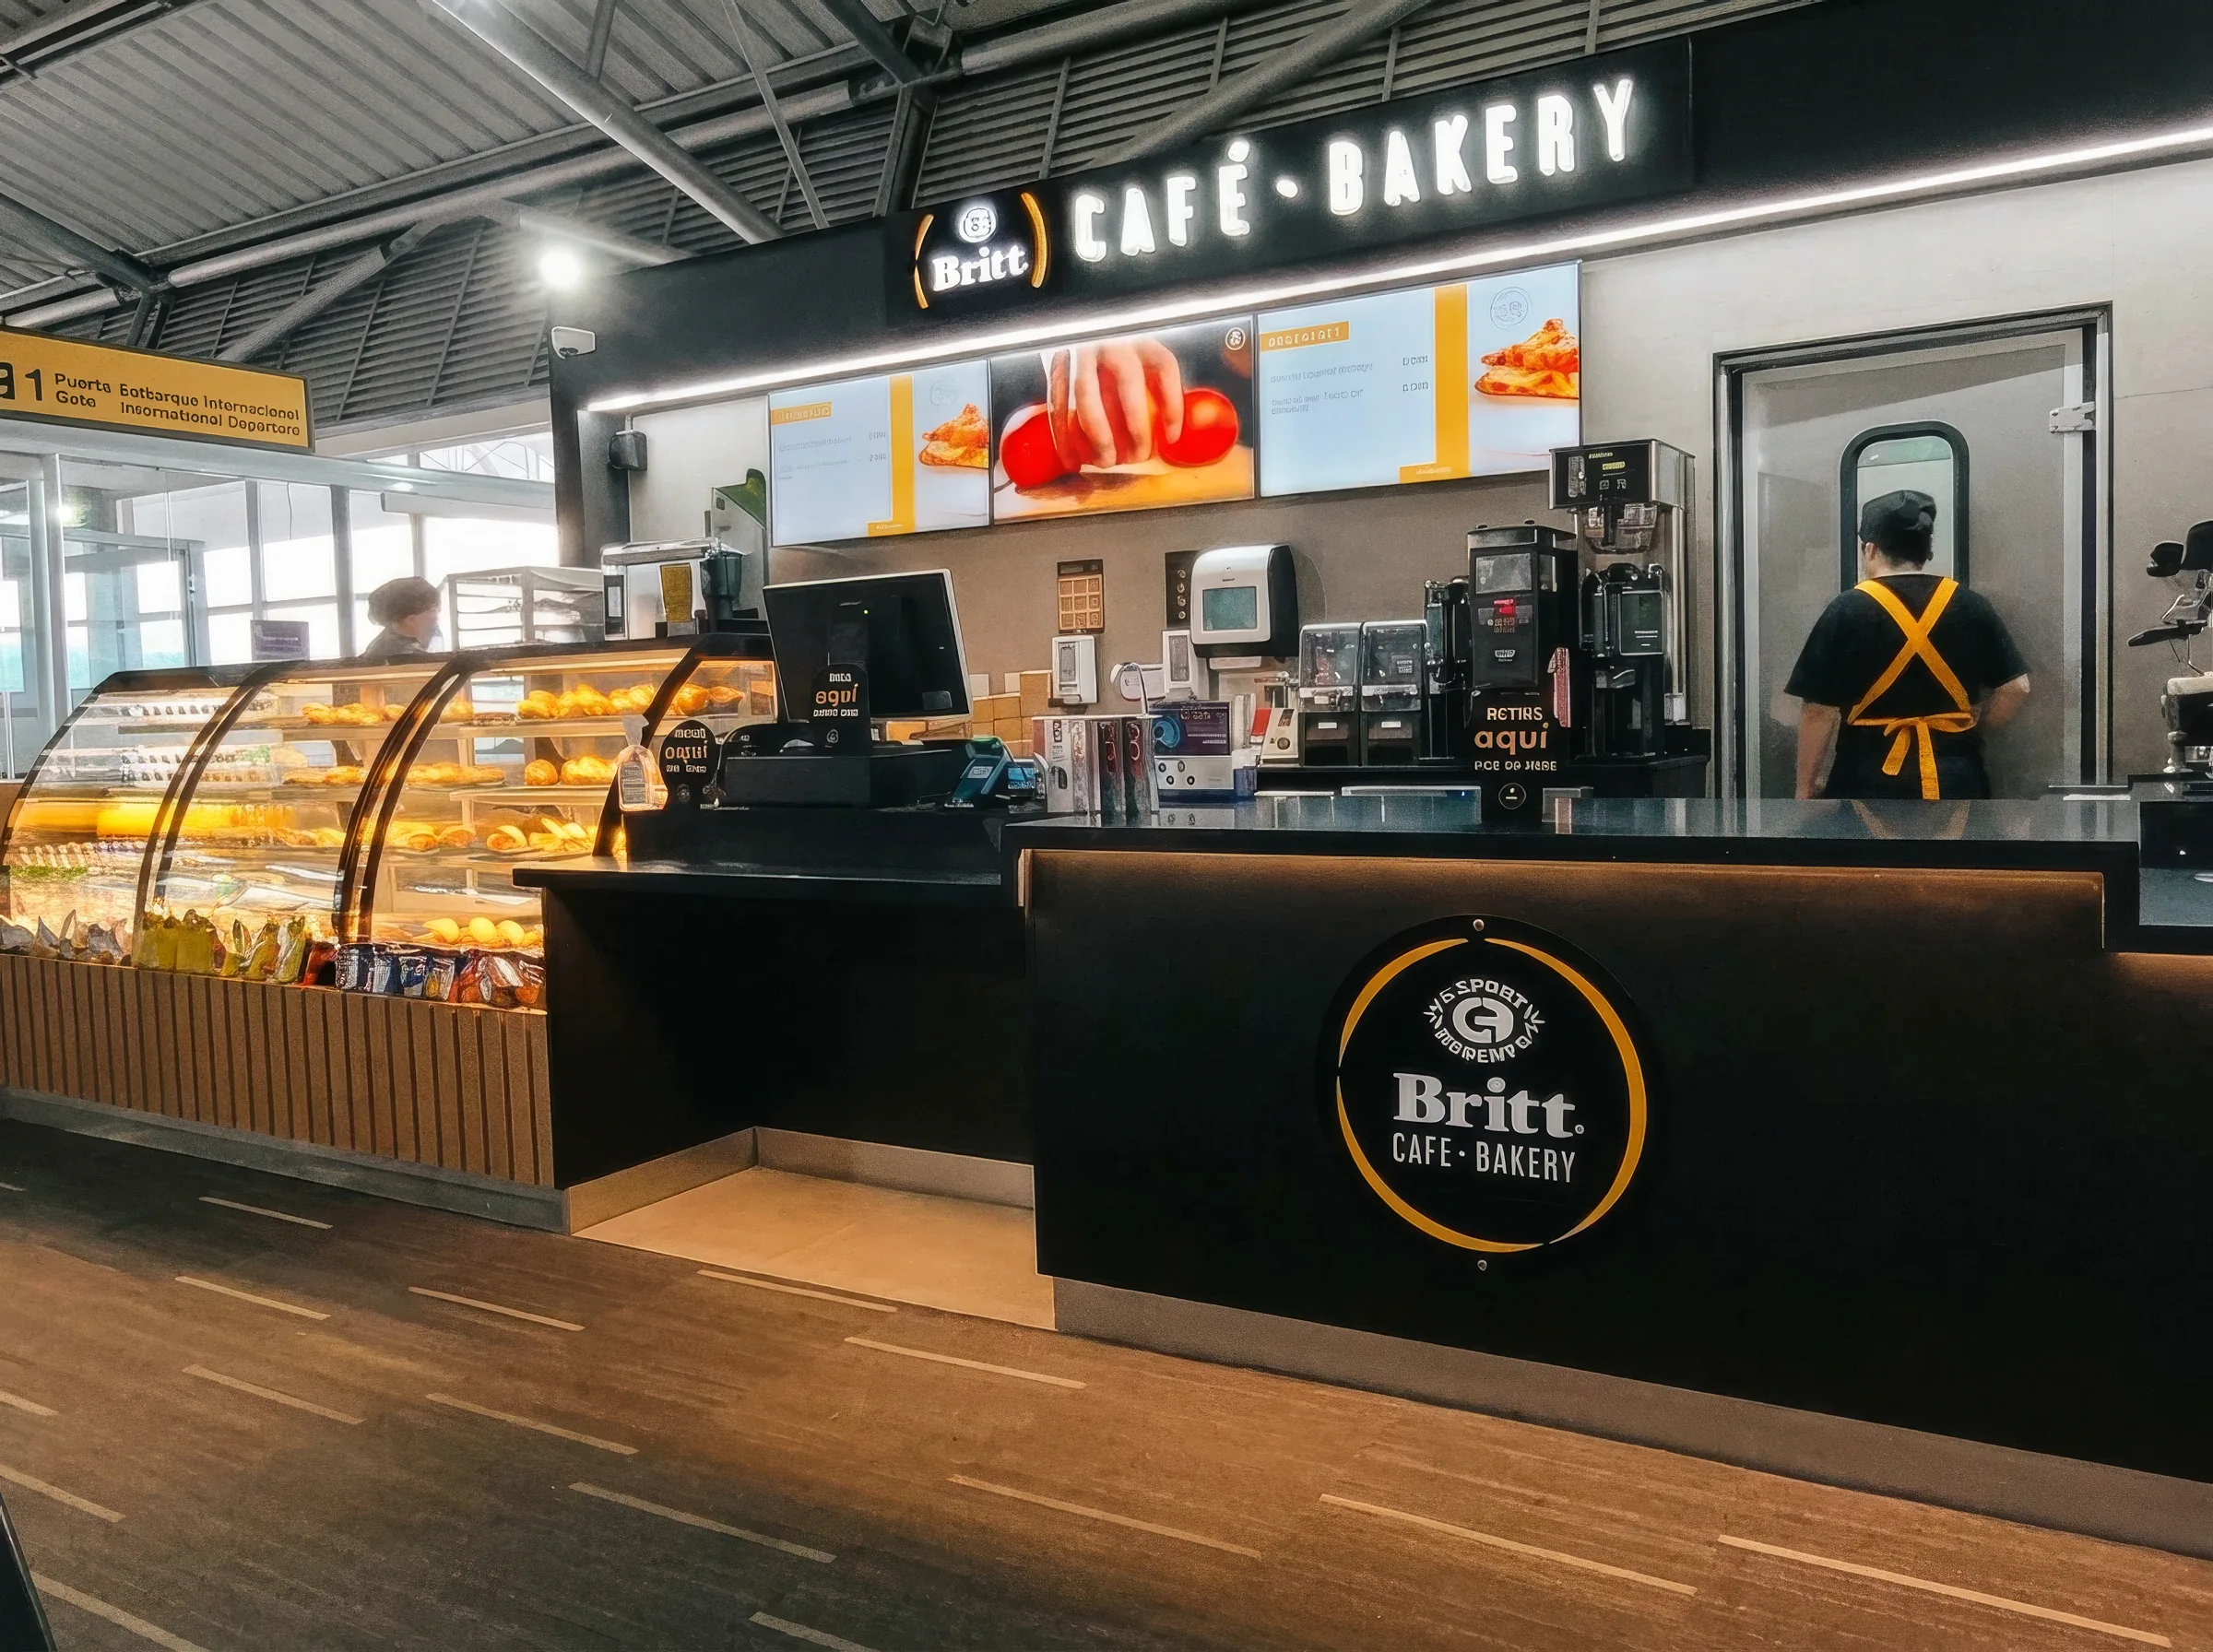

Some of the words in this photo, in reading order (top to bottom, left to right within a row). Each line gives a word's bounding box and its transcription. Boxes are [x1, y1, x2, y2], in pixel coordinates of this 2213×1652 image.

[1329, 78, 1634, 216] BAKERY
[931, 244, 1029, 292] Britt
[1392, 1072, 1577, 1139] Britt
[1392, 1132, 1451, 1167] CAFE
[1476, 1141, 1577, 1183] BAKERY
